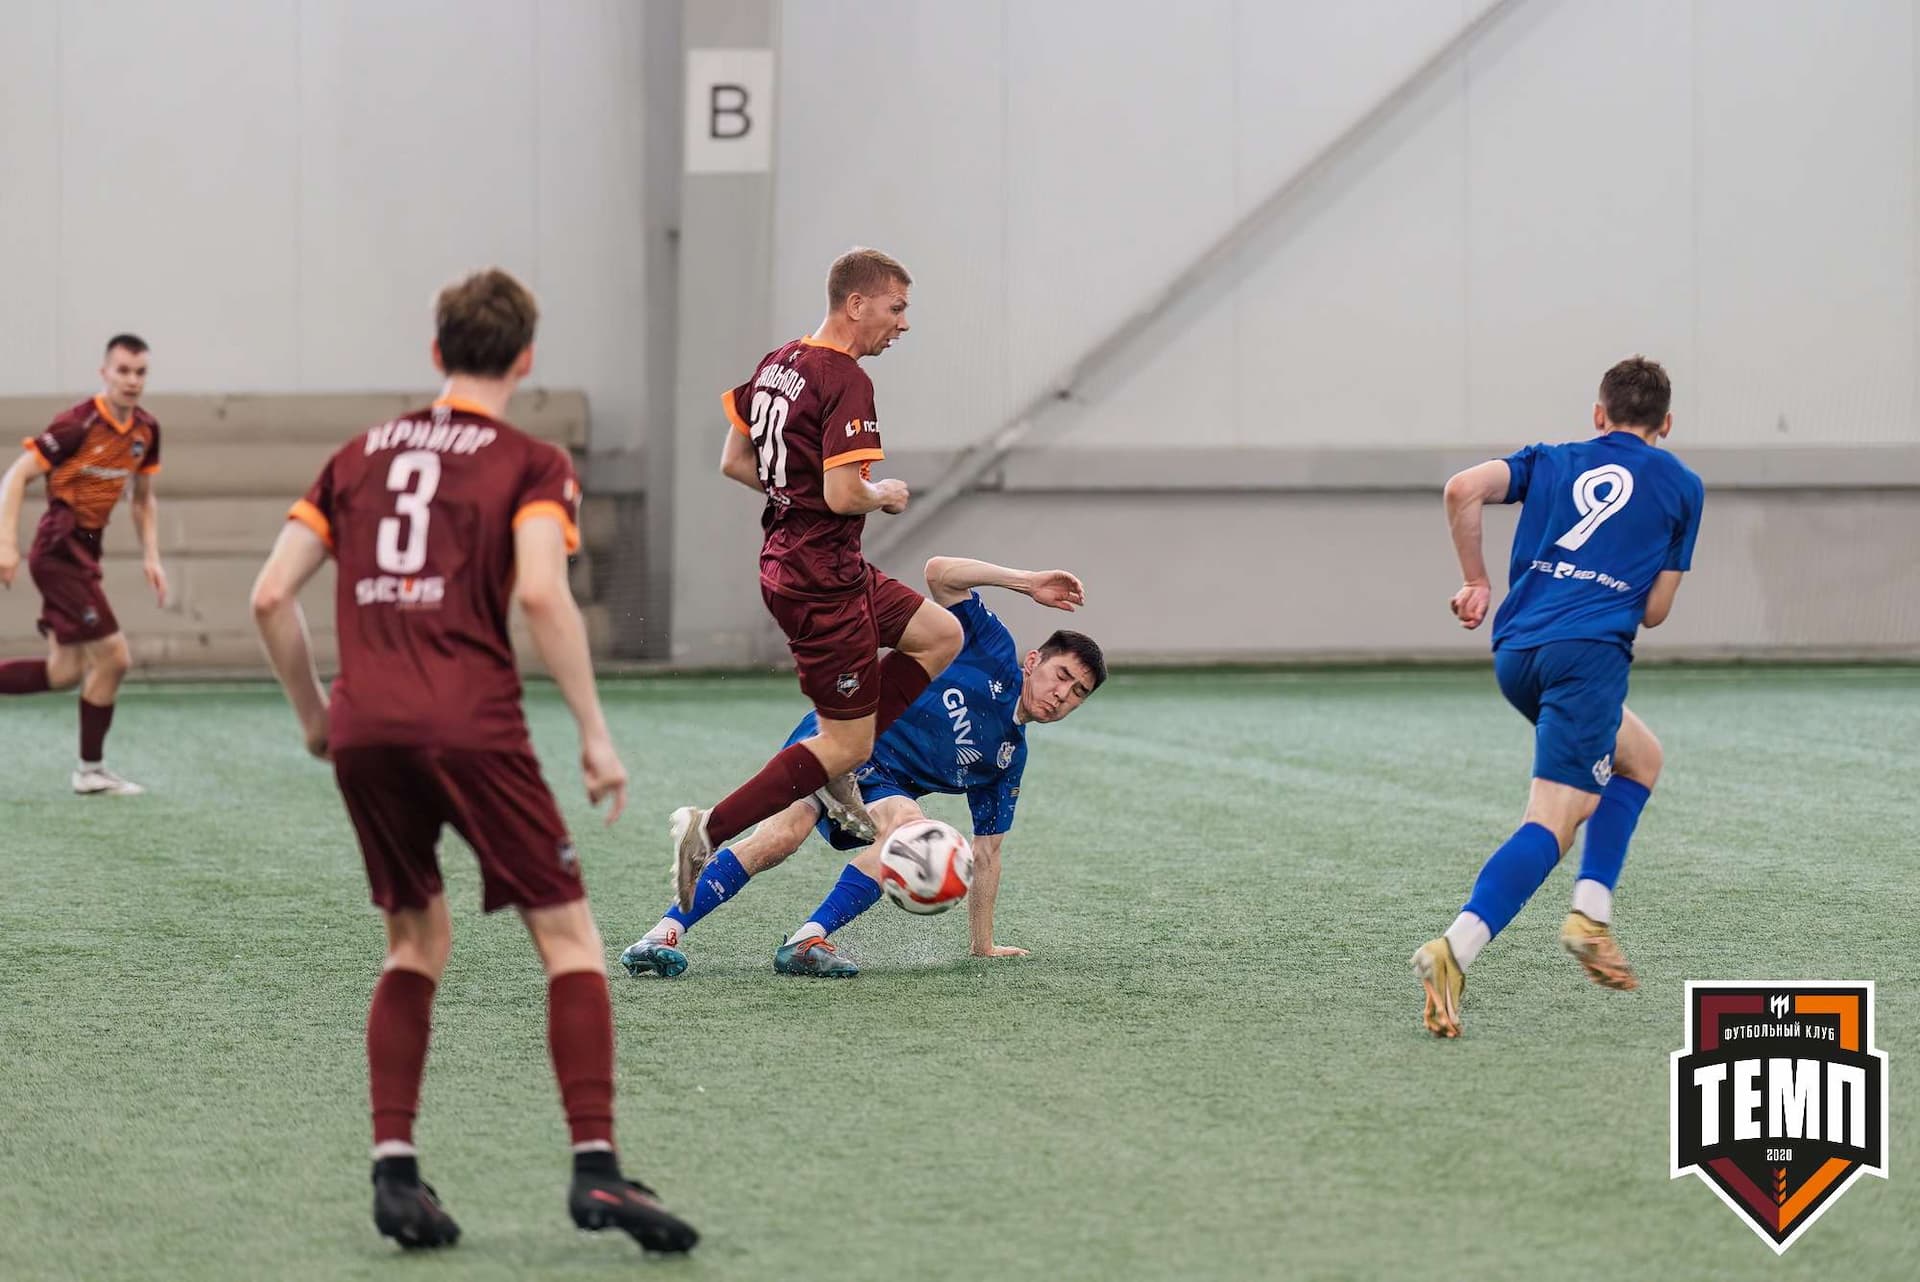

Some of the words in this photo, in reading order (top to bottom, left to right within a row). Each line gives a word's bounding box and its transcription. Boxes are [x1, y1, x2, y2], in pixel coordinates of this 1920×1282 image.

[376, 450, 441, 575] 3
[1554, 464, 1634, 551] 9
[942, 687, 974, 746] GNV
